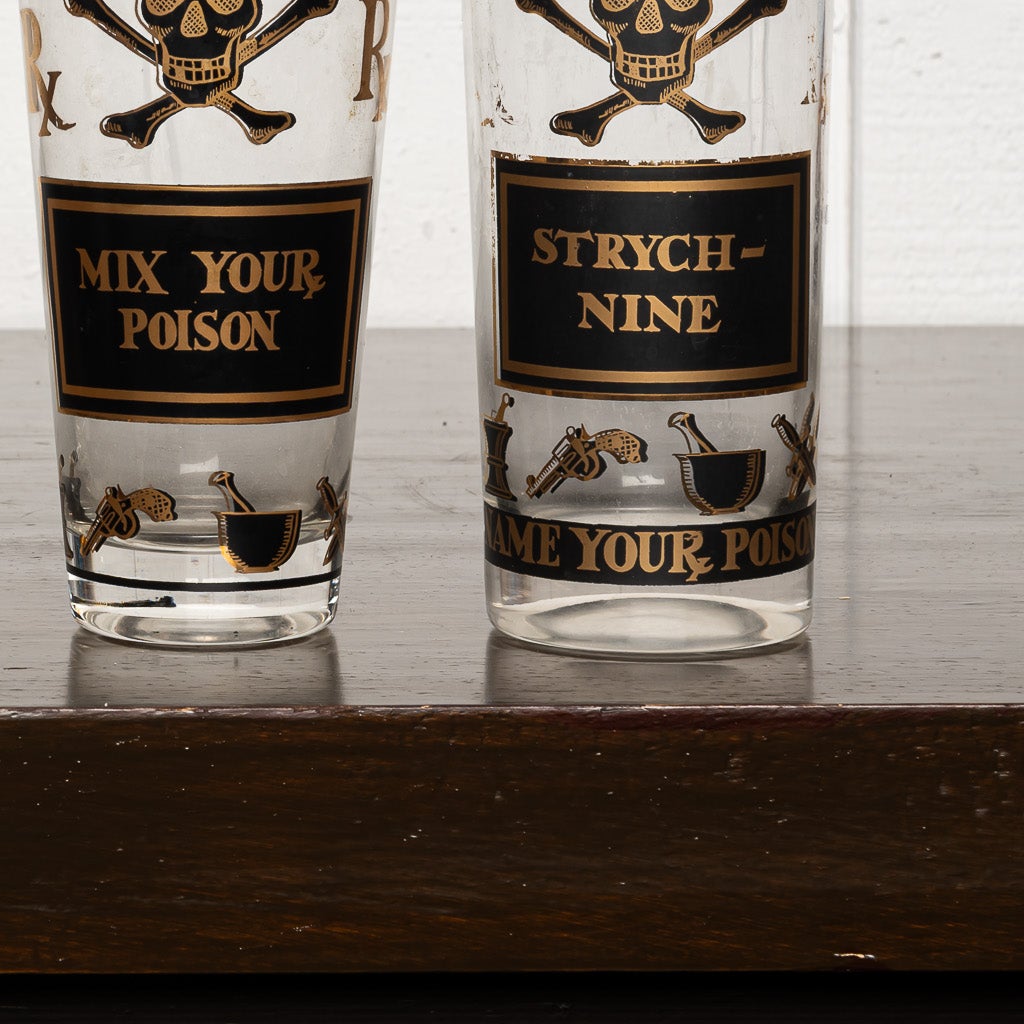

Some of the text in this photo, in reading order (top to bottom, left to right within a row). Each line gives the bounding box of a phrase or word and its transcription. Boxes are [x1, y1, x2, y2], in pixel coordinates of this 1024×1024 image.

[76, 247, 169, 294] MIX
[532, 228, 766, 272] STRYCH-
[118, 308, 280, 351] POISON
[577, 292, 722, 333] NINE
